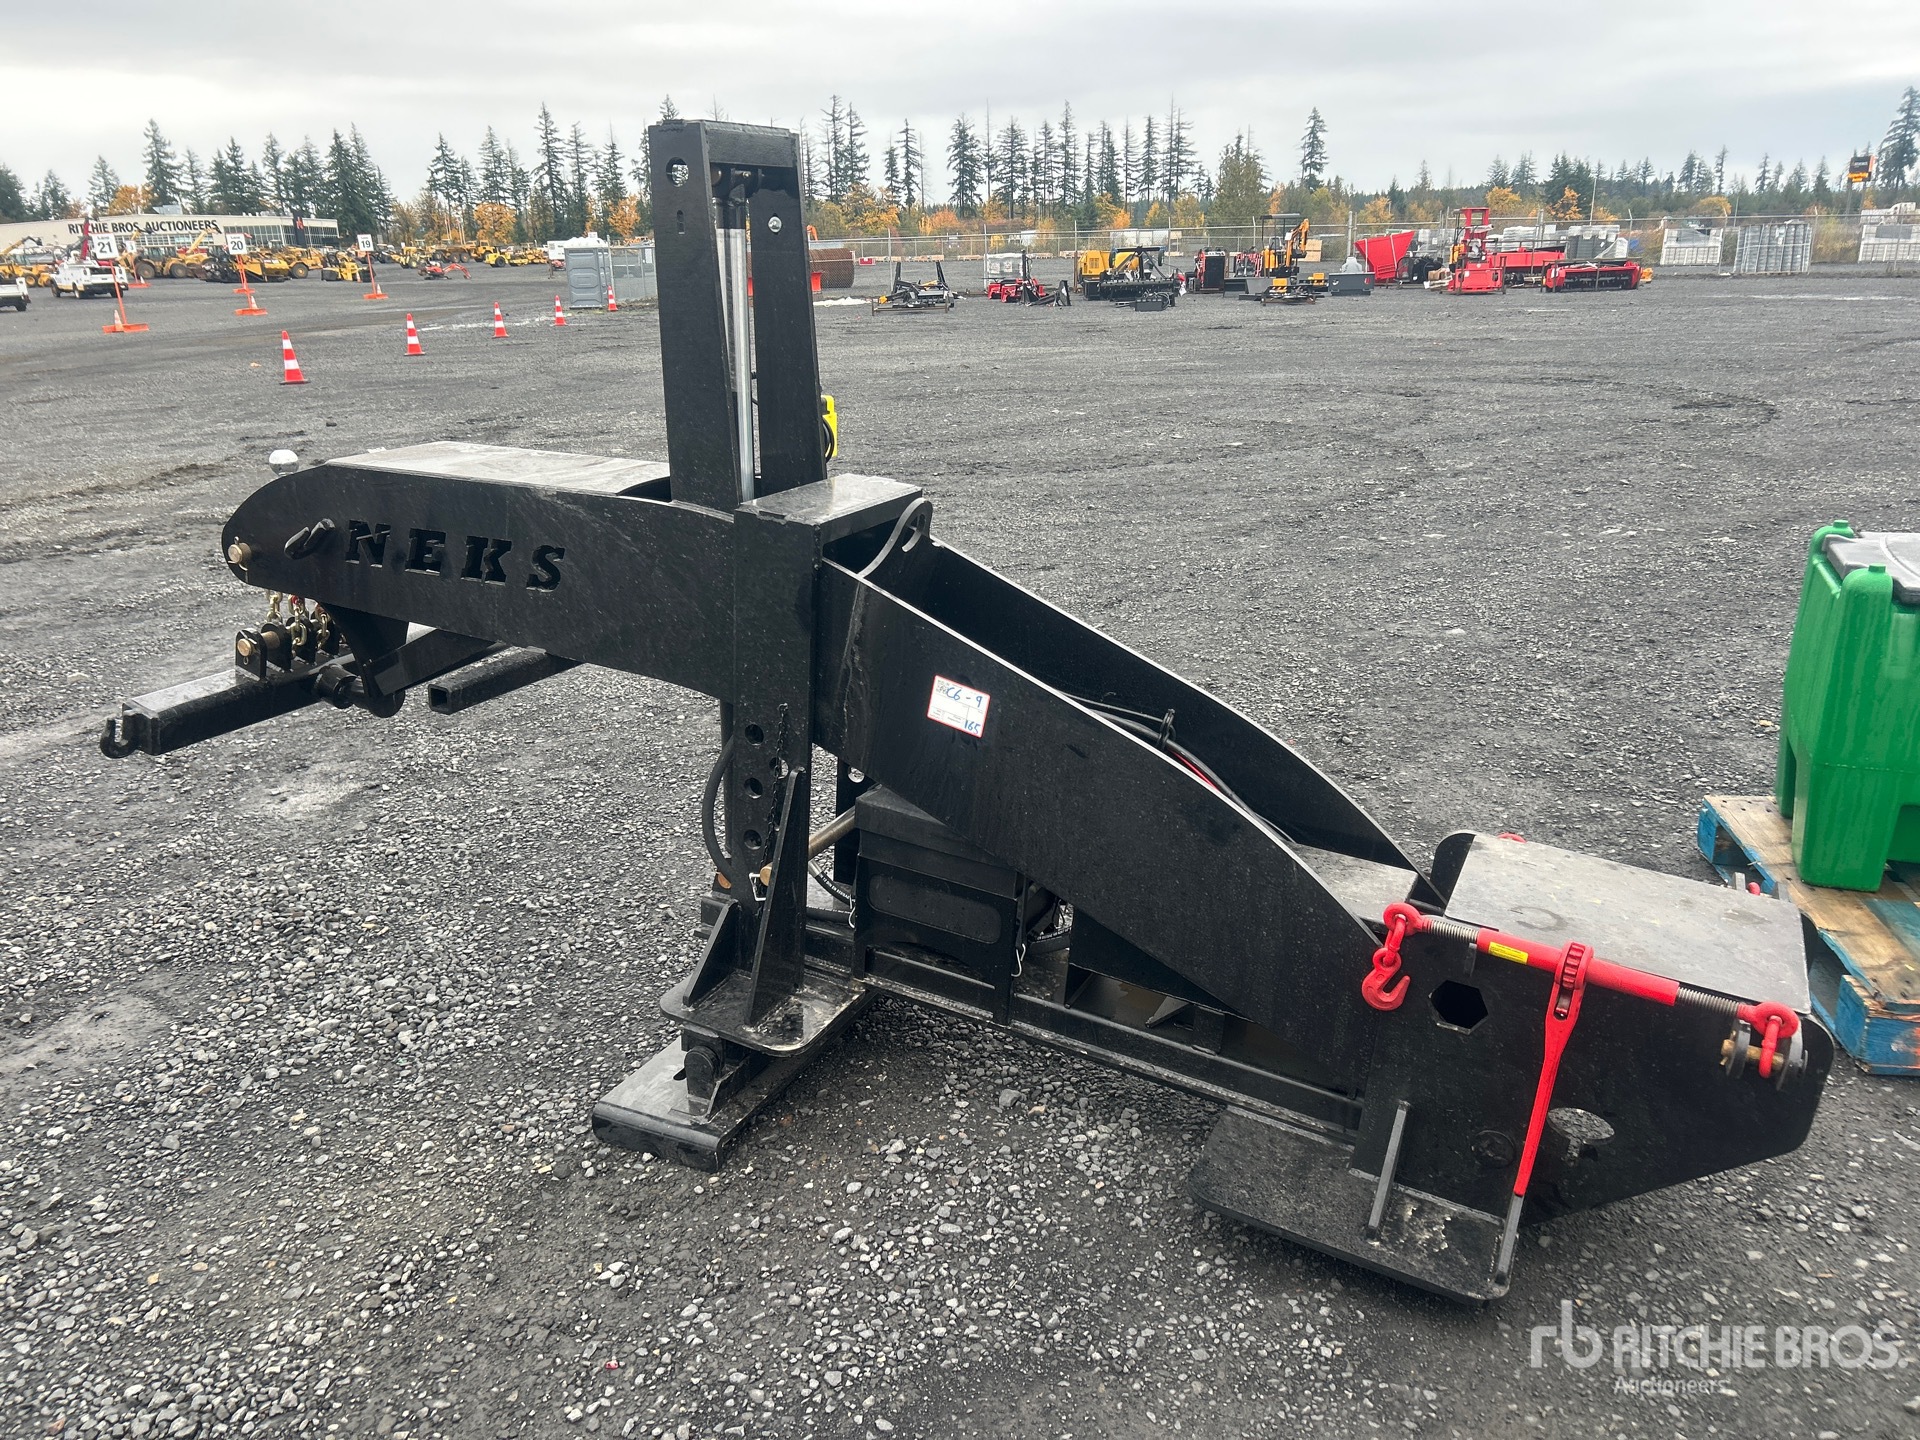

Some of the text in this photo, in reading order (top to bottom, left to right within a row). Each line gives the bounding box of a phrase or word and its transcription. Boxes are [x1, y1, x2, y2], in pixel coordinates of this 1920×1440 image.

[68, 222, 109, 234] RITHIE
[145, 219, 219, 232] AUCTIONEERS
[97, 241, 113, 253] 21
[230, 240, 244, 250] 20
[361, 240, 371, 248] 19
[345, 519, 566, 593] NEKS
[964, 720, 982, 734] 165
